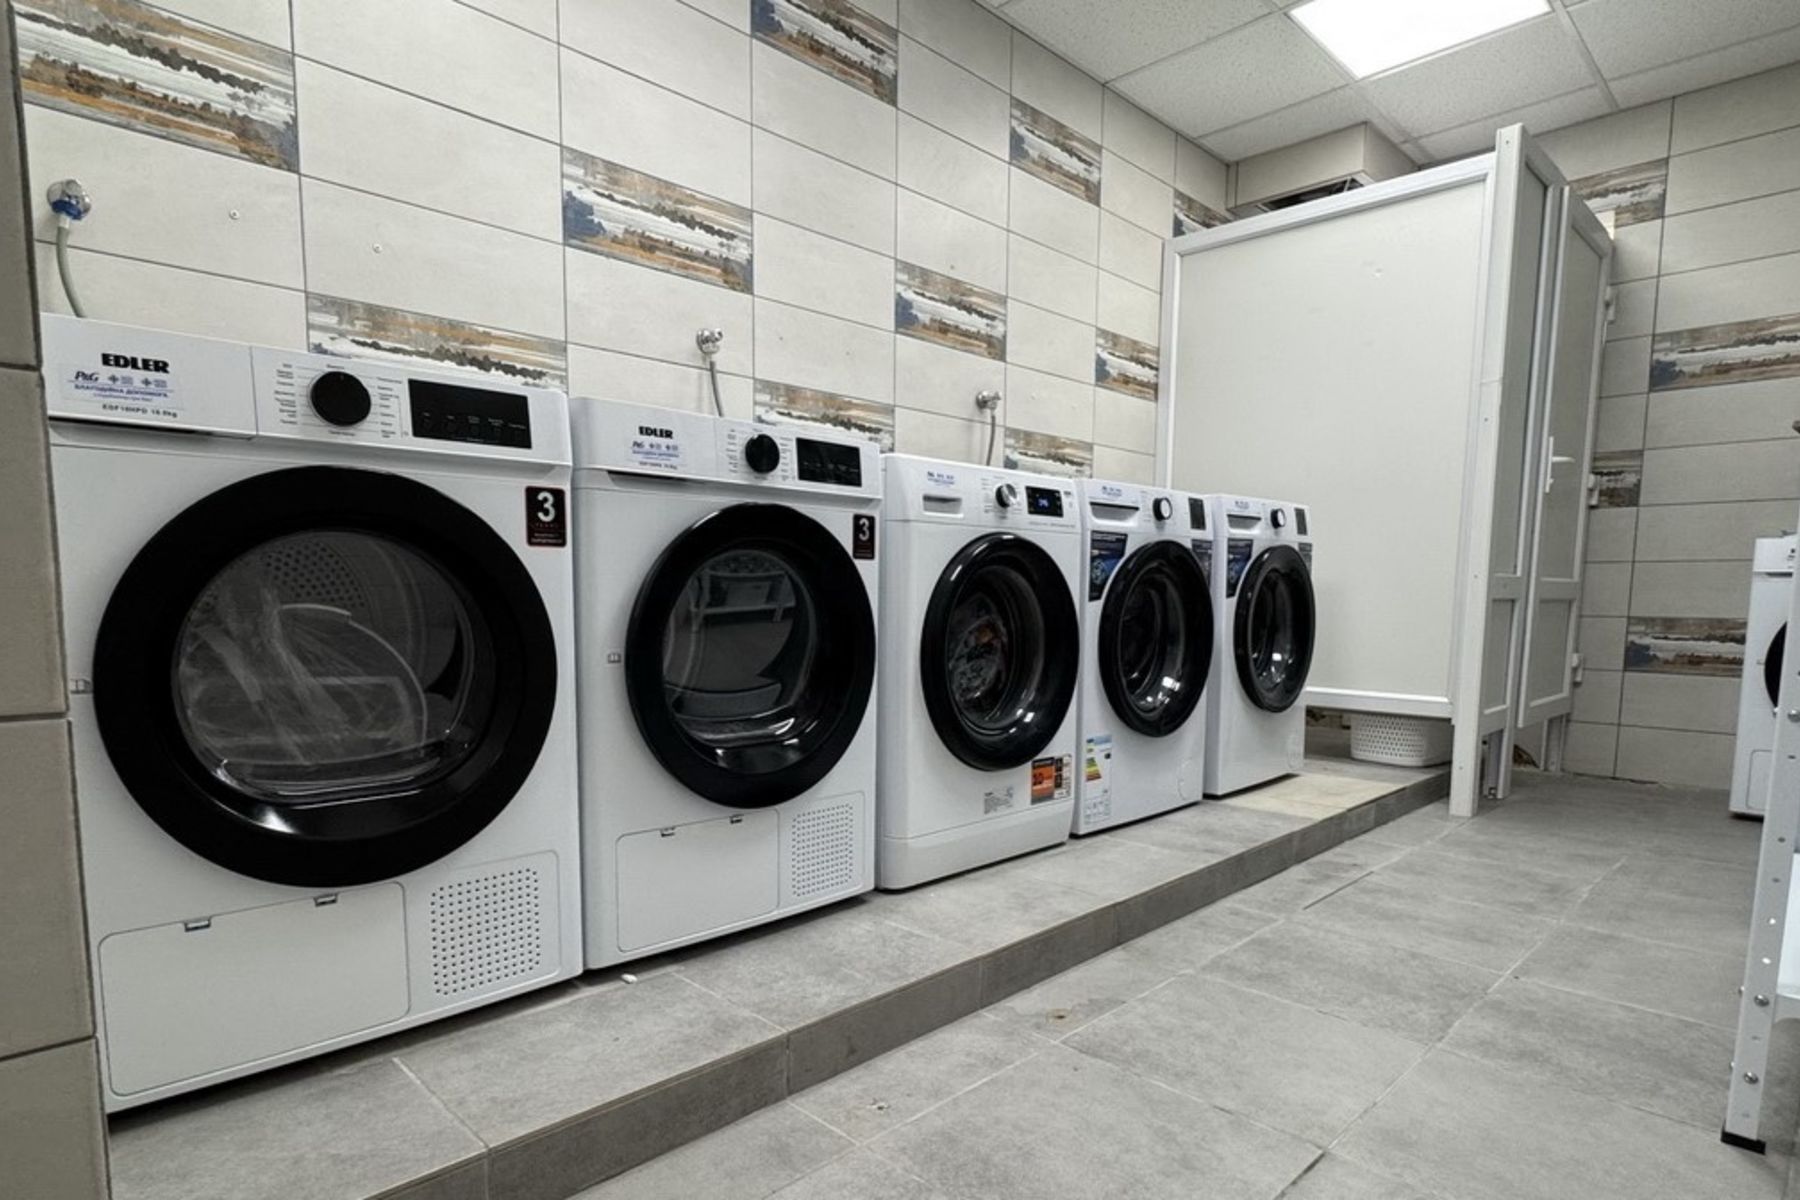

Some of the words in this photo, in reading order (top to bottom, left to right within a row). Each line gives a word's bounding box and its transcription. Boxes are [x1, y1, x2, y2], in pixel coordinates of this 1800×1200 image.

[101, 353, 170, 374] EDLER
[638, 425, 673, 440] EDLER
[537, 490, 556, 523] 3
[859, 517, 870, 541] 3
